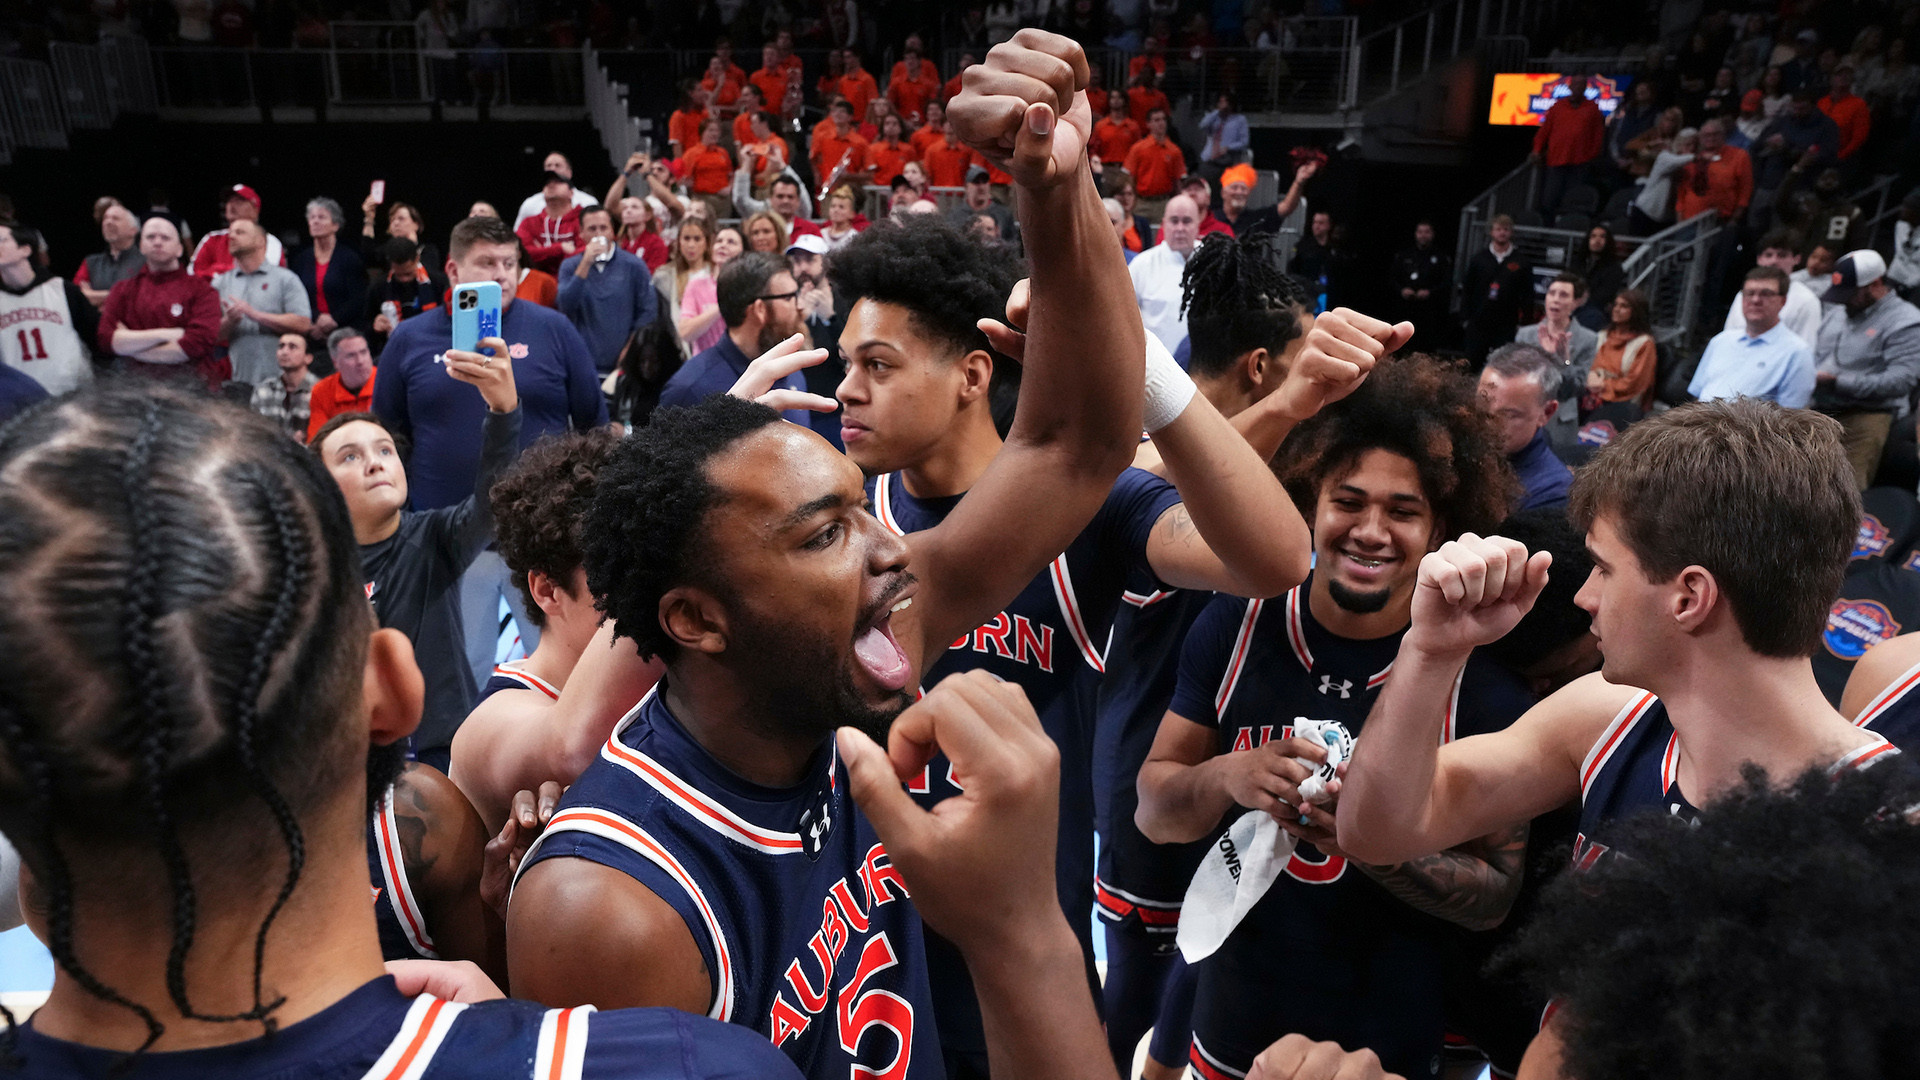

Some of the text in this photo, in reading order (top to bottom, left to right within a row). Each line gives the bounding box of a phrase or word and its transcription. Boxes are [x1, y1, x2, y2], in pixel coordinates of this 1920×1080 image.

[18, 328, 48, 360] 11
[770, 843, 911, 1049] AUBUR
[837, 931, 914, 1080] 5
